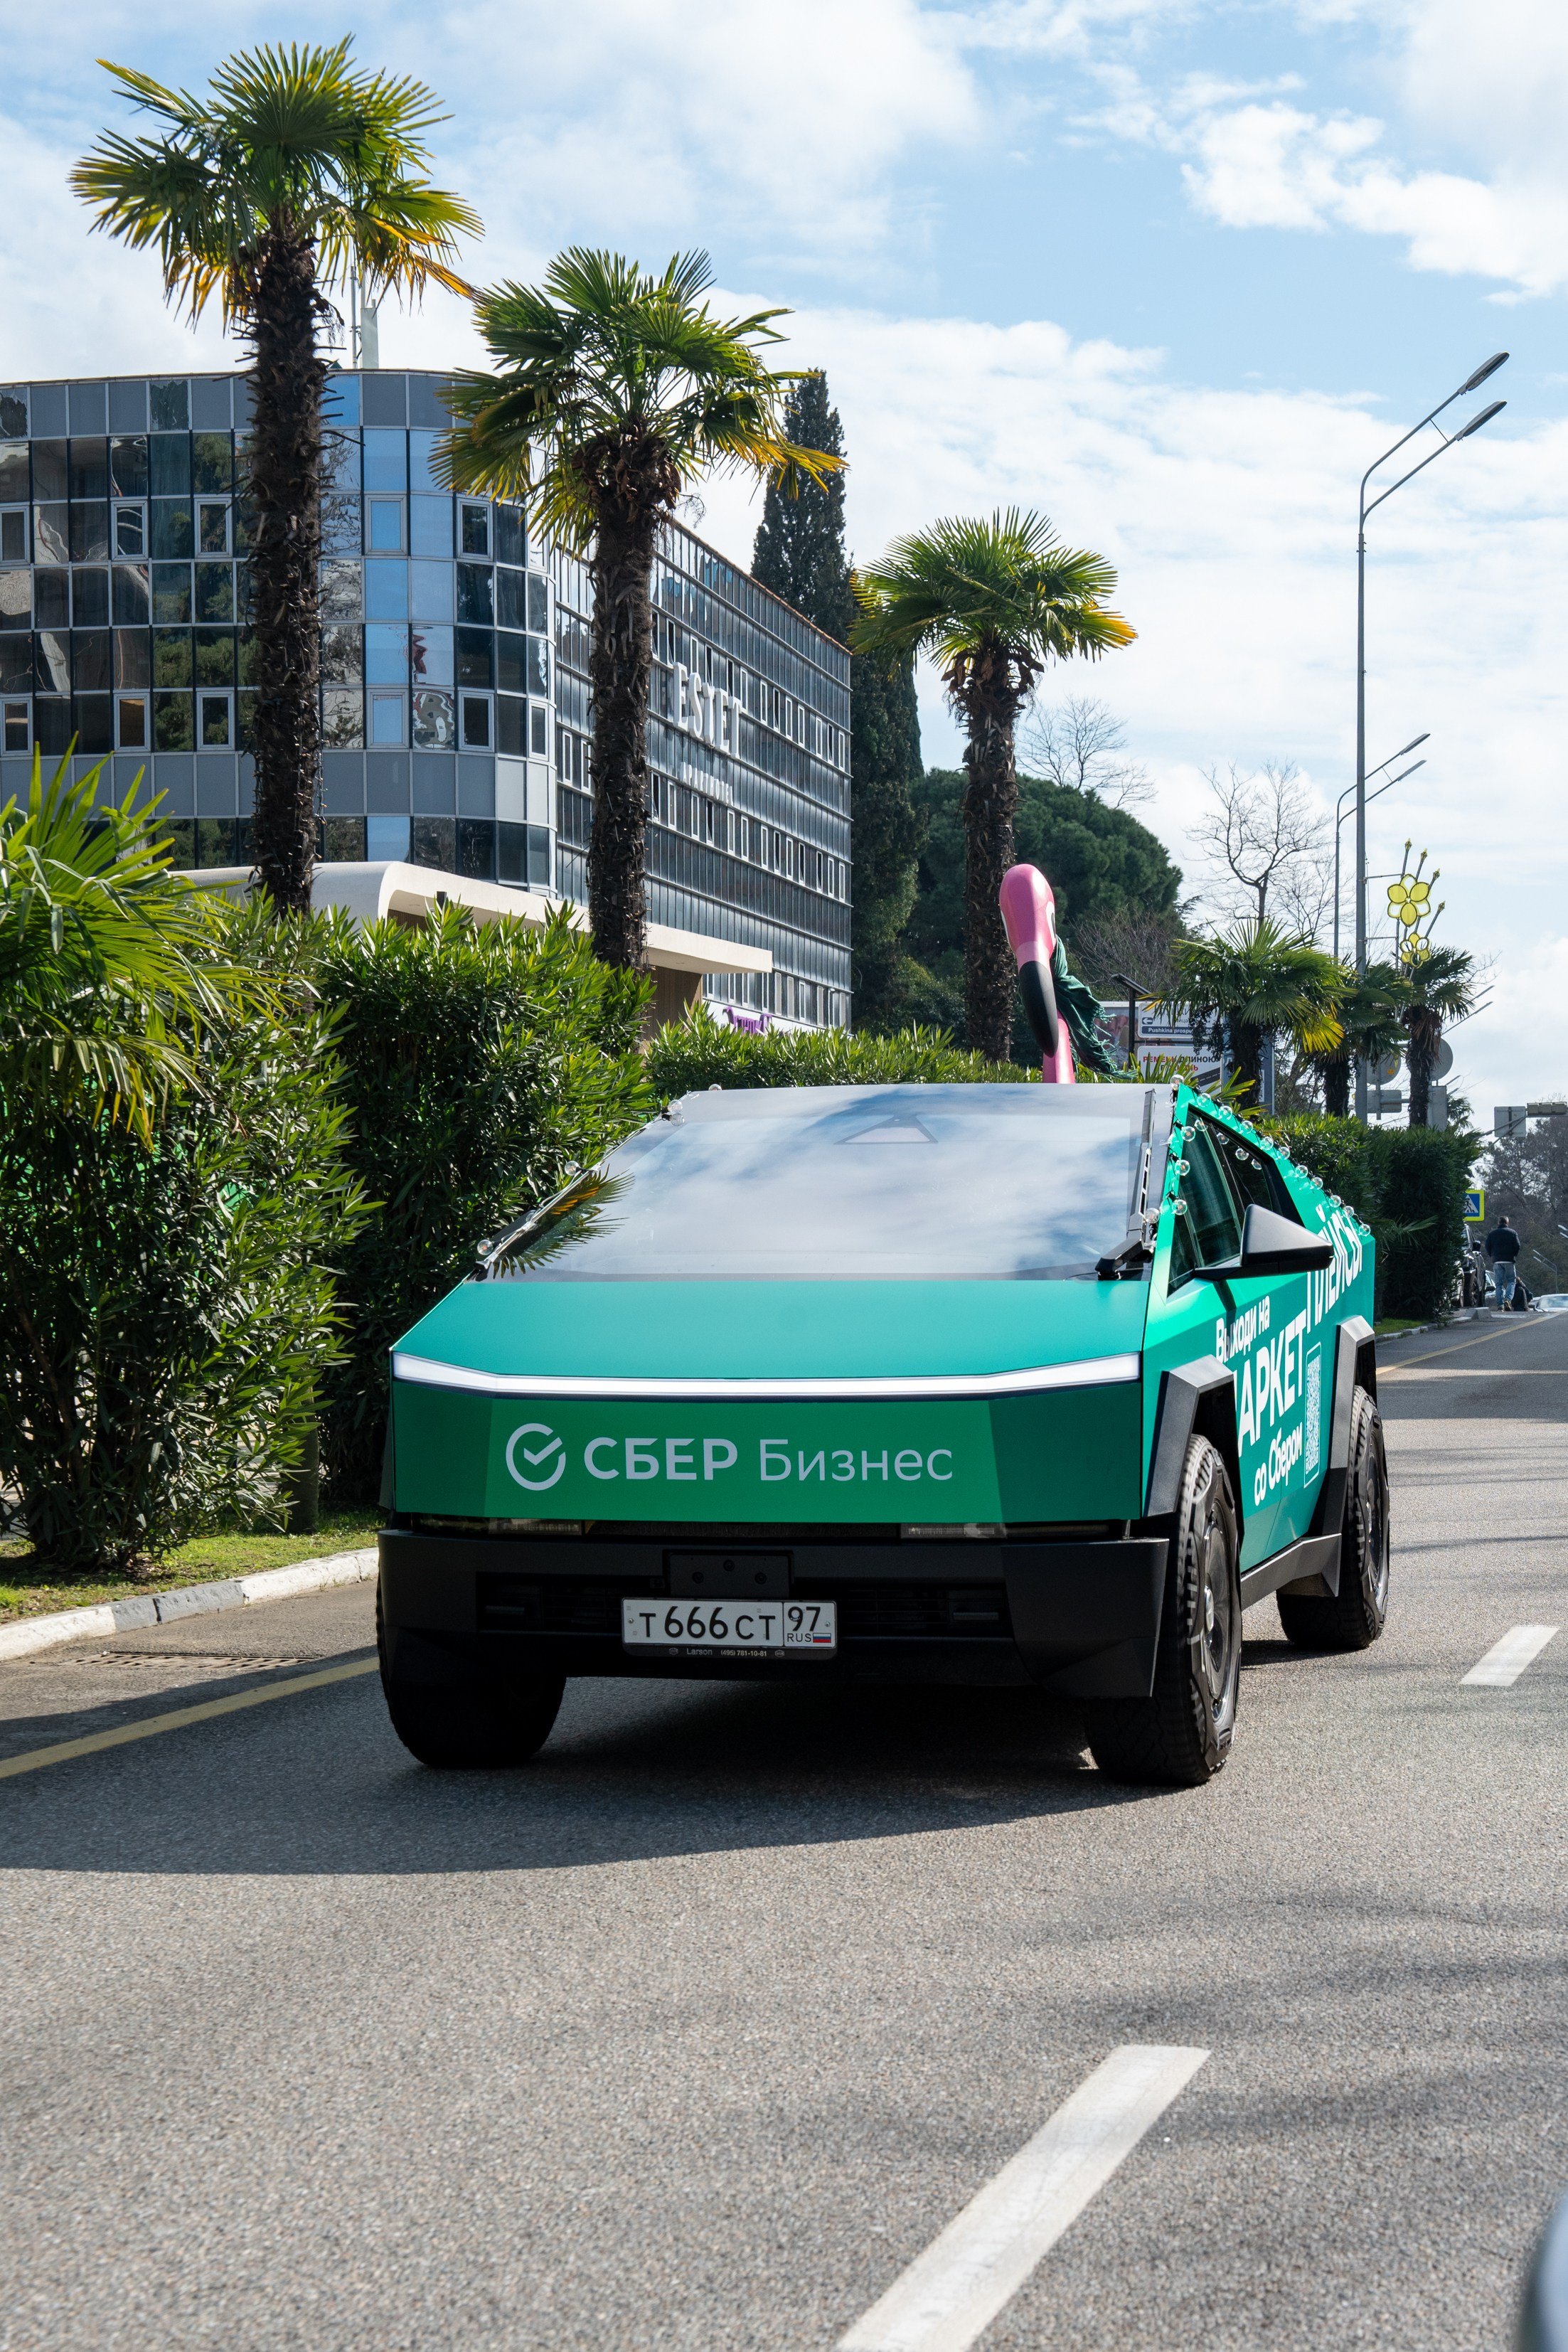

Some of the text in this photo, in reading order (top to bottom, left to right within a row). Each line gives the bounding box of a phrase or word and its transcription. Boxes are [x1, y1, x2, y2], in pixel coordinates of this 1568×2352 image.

[673, 661, 742, 760] ESTET
[680, 761, 734, 807] APARTHOTEL
[1216, 1295, 1270, 1363] Выходи на
[1234, 1309, 1306, 1458] АРКЕТ
[583, 1437, 953, 1481] СБЕР Бизнес
[1254, 1421, 1302, 1506] со Сбером
[786, 1633, 812, 1643] RUS
[787, 1605, 821, 1632] 97
